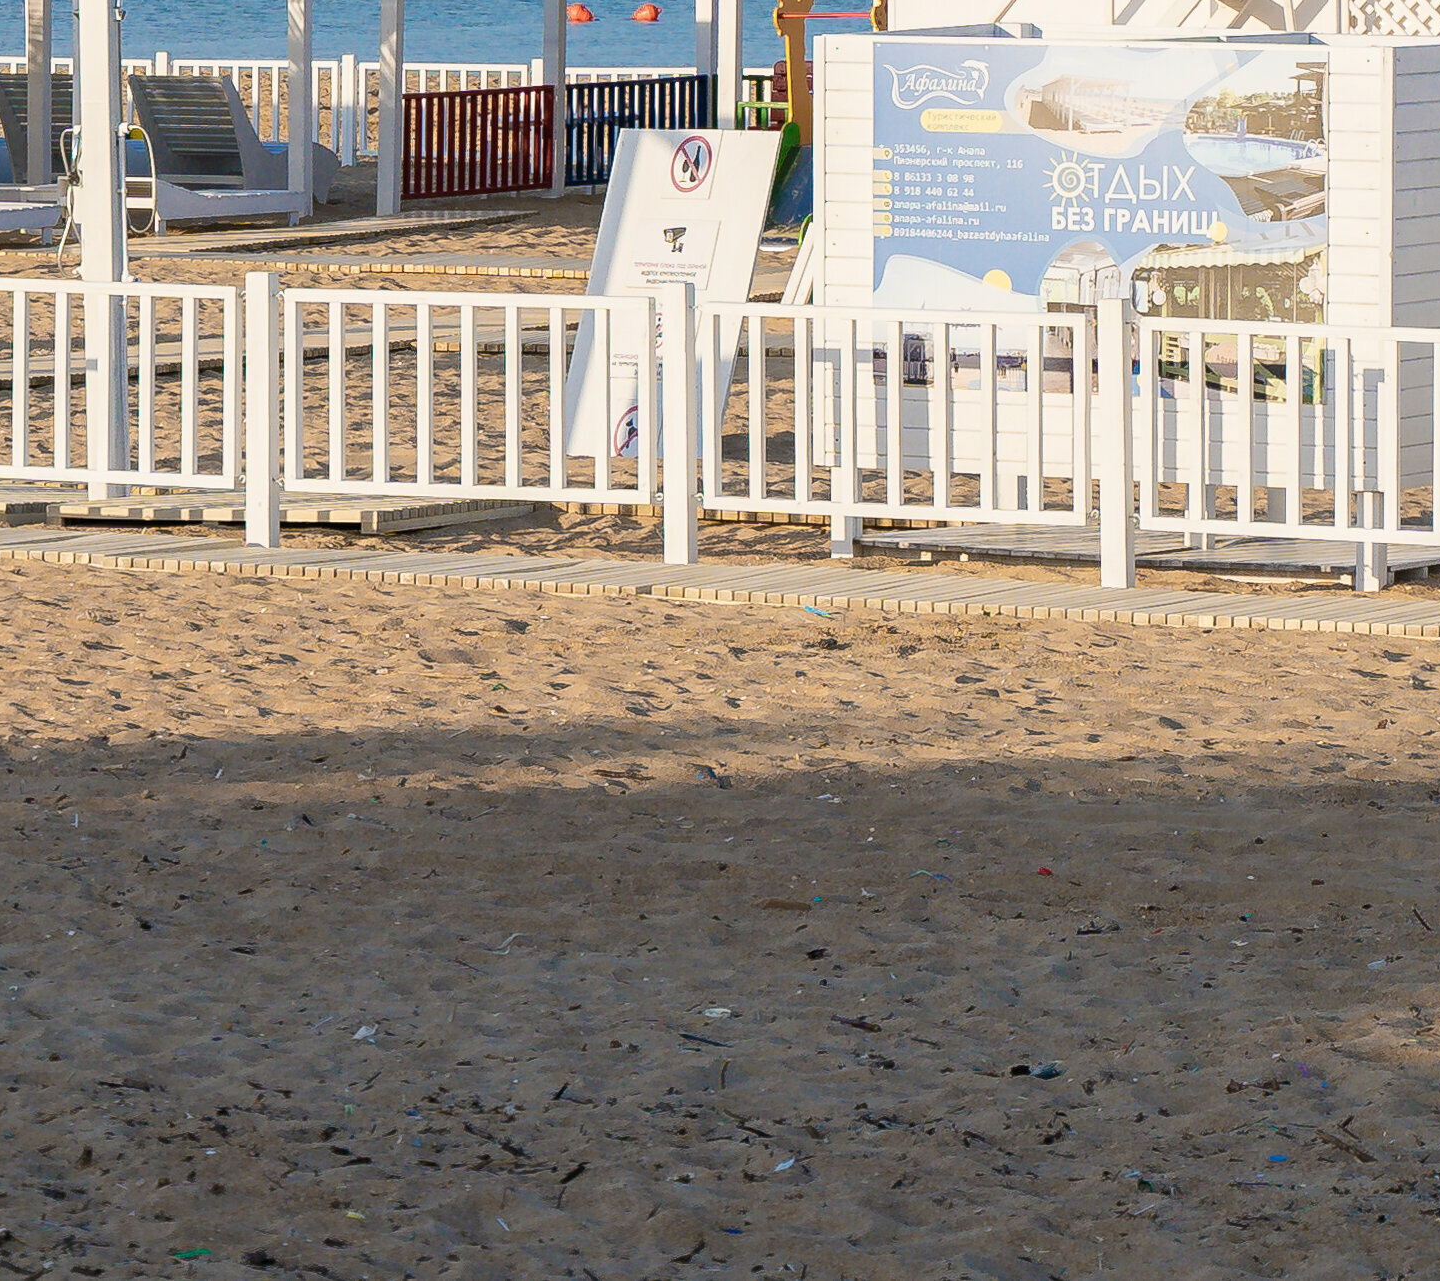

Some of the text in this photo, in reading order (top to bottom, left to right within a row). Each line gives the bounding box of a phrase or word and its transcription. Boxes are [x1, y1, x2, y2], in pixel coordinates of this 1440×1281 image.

[900, 73, 978, 96] Афалина
[927, 111, 997, 122] Туристический
[927, 123, 969, 132] комплекс
[958, 146, 986, 156] Анапа
[893, 156, 948, 168] Пионерский
[893, 172, 900, 182] 8
[936, 173, 943, 182] 3
[1051, 160, 1196, 205] ОТДЫХ
[893, 186, 900, 195] 8
[904, 186, 921, 196] 918
[947, 187, 959, 197] 62
[962, 187, 975, 197] 44
[1051, 206, 1095, 232] БЕЗ
